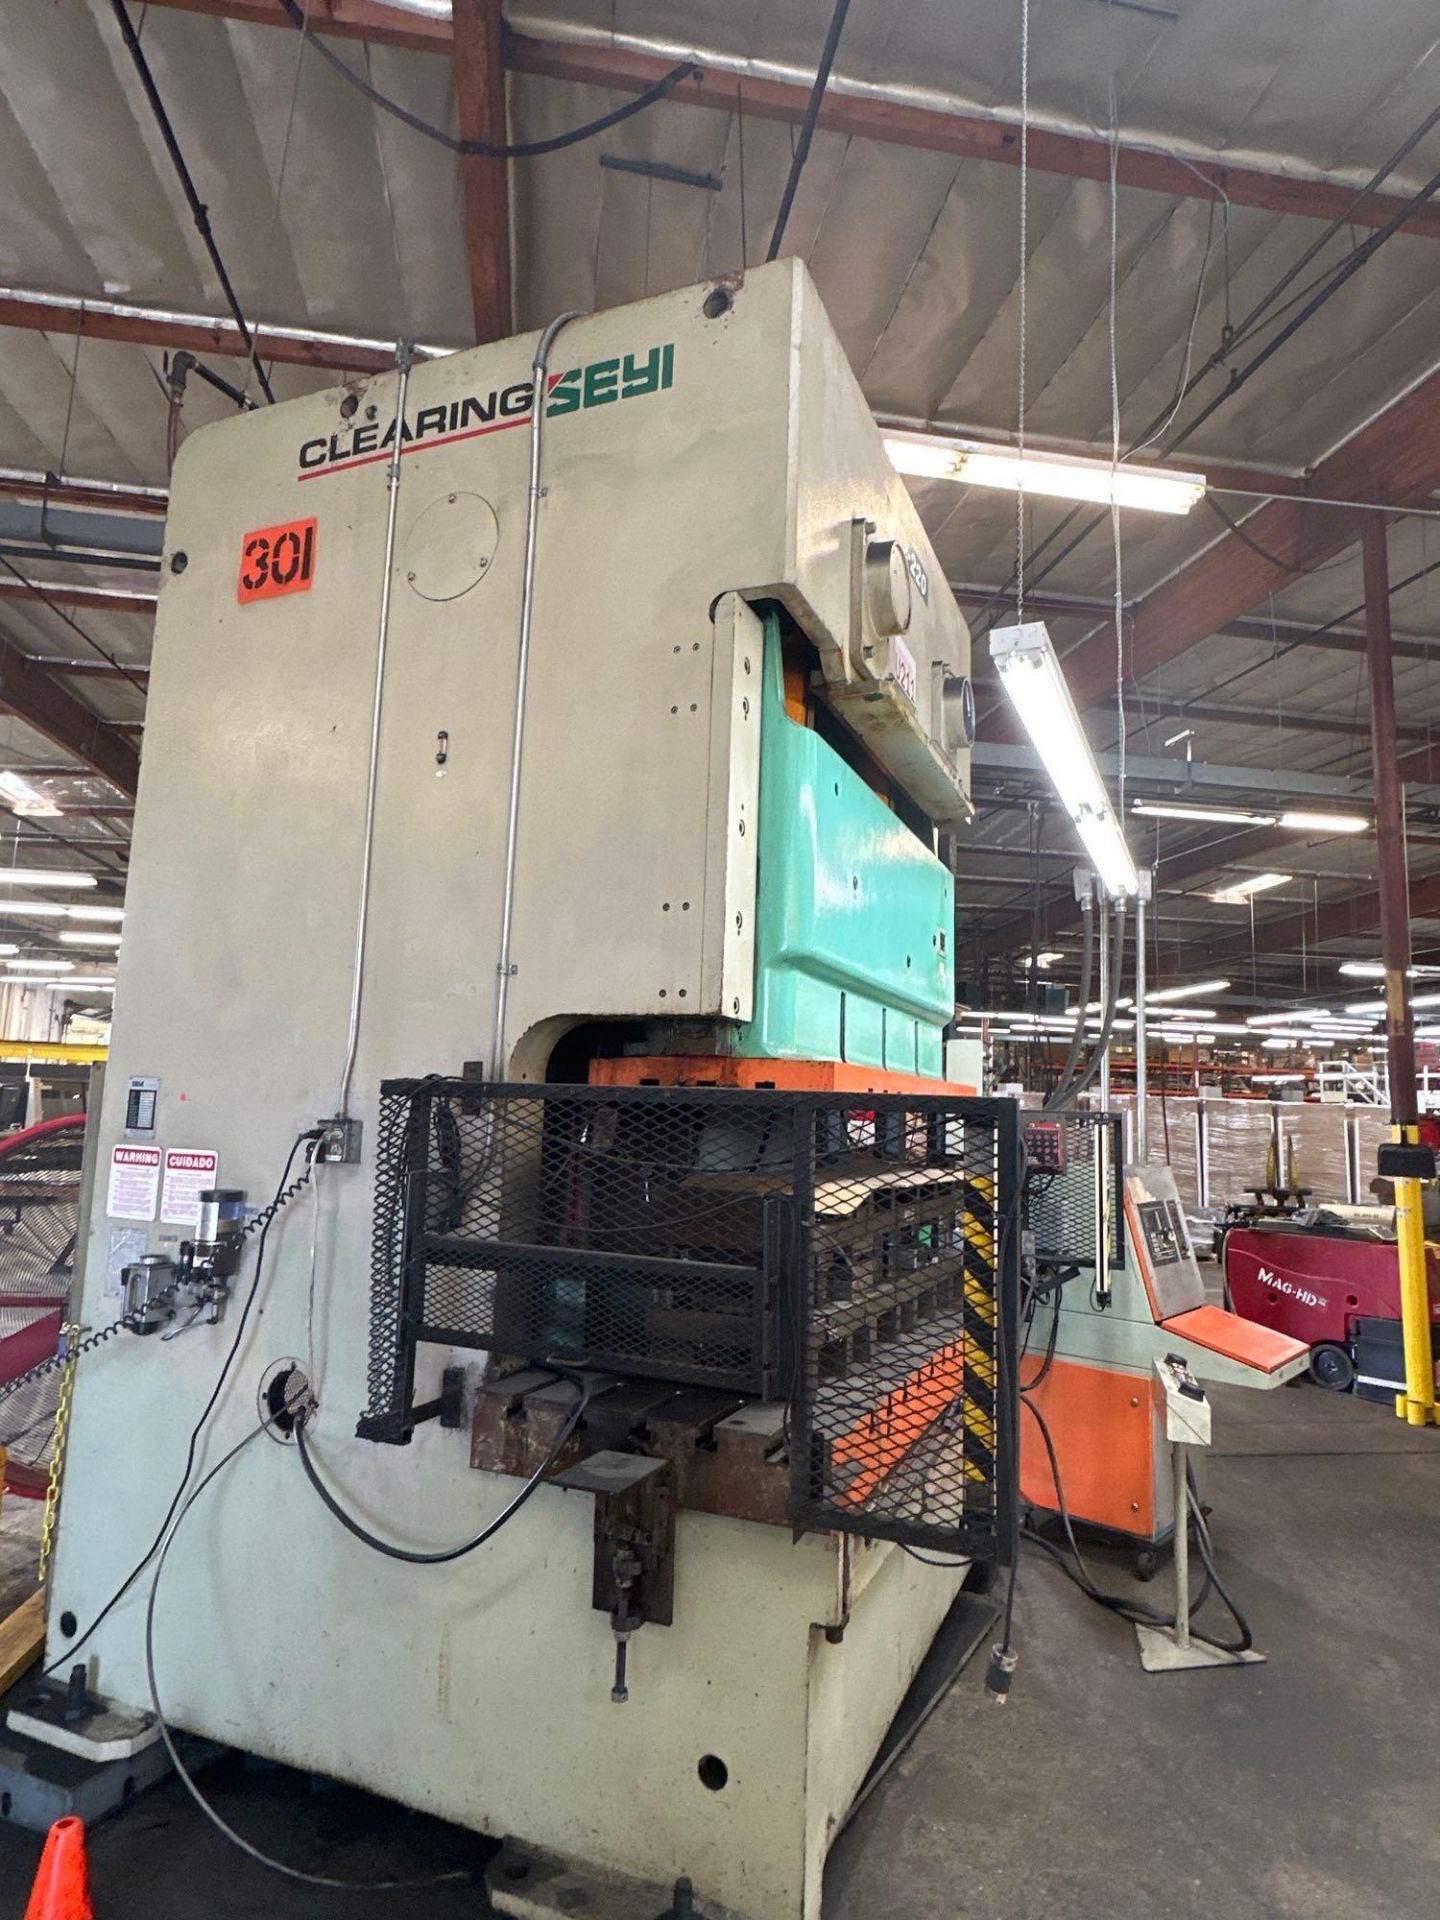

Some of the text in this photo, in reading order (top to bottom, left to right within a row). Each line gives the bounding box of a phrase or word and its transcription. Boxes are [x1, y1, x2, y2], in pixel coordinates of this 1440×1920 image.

[299, 343, 674, 469] CLEARING SEYI
[243, 526, 313, 590] 301
[115, 1150, 158, 1164] WARNING
[169, 1155, 213, 1169] CUIDADO
[1257, 1267, 1317, 1307] MAG-HD
